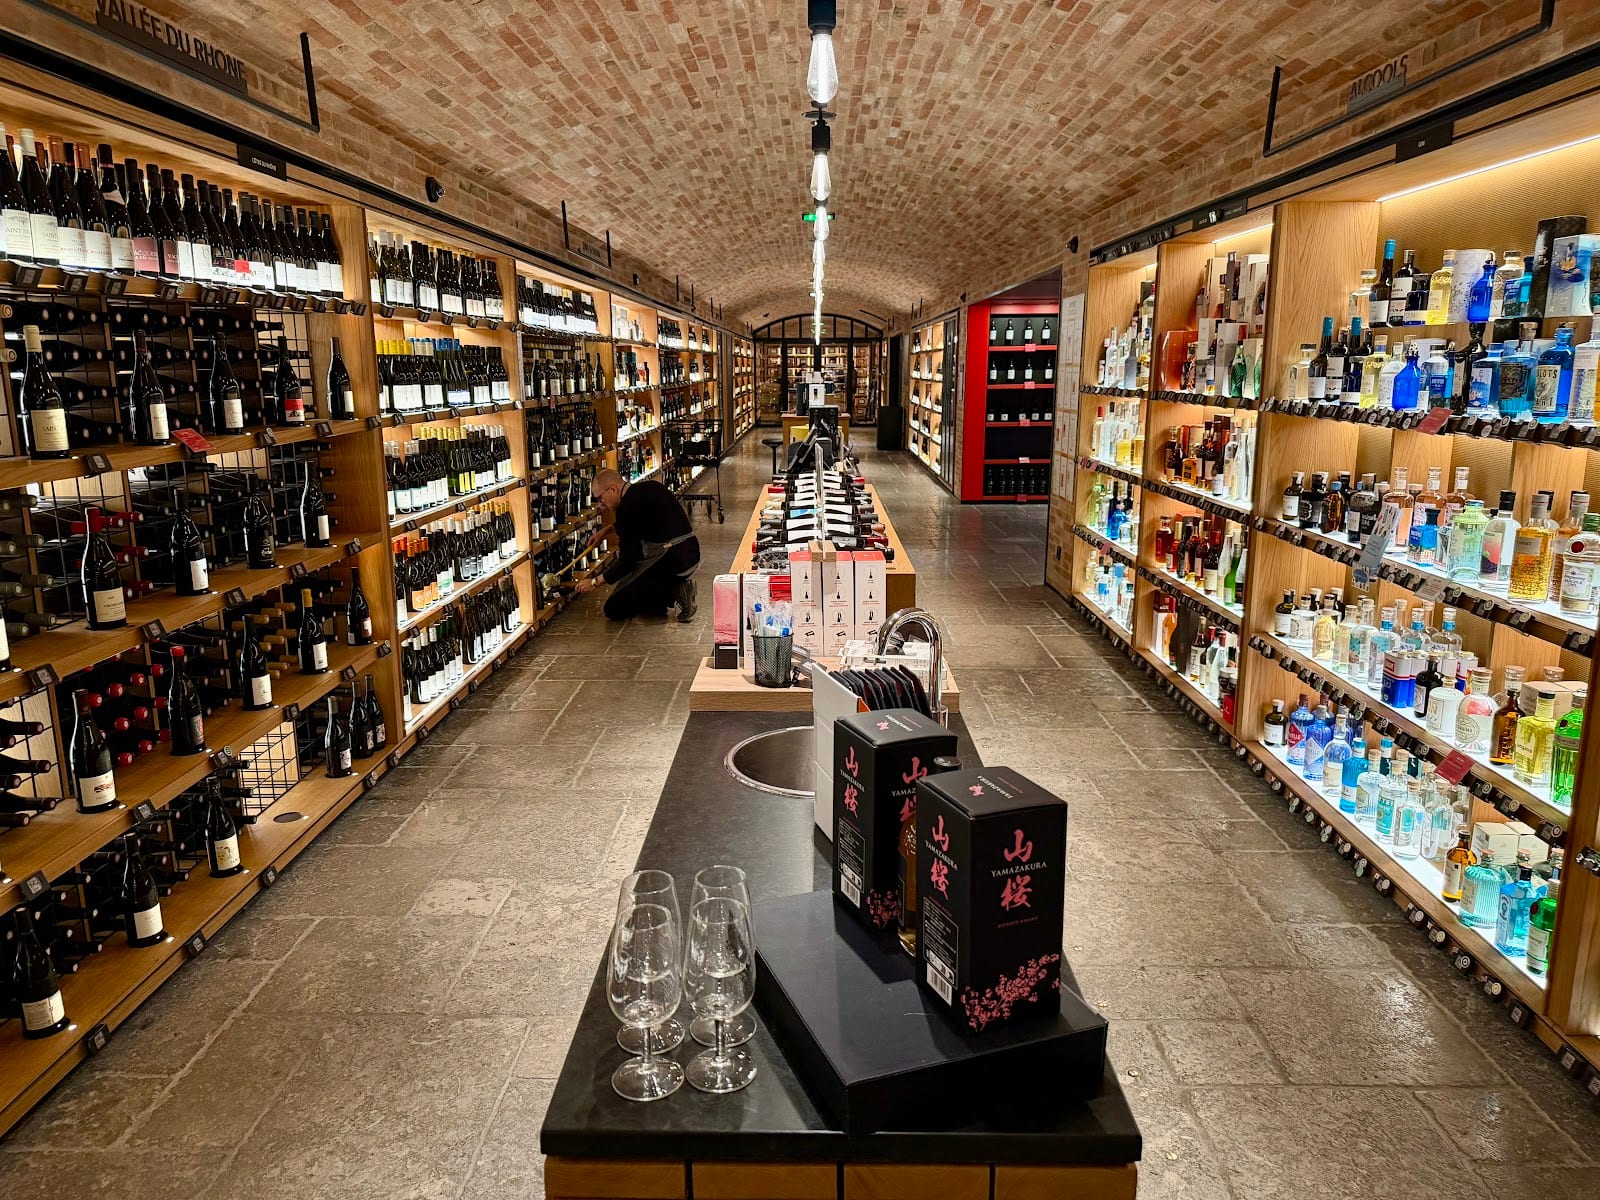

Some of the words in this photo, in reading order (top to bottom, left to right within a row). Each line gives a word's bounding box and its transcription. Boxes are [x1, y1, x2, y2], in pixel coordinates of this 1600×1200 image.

[165, 23, 191, 54] DU
[1349, 54, 1409, 101] ALCOOLS
[839, 769, 865, 793] YAMAZAKURA
[925, 839, 958, 871] YAMAZAKURA
[1003, 828, 1033, 863] 山
[991, 861, 1047, 878] YAMAZAKURA
